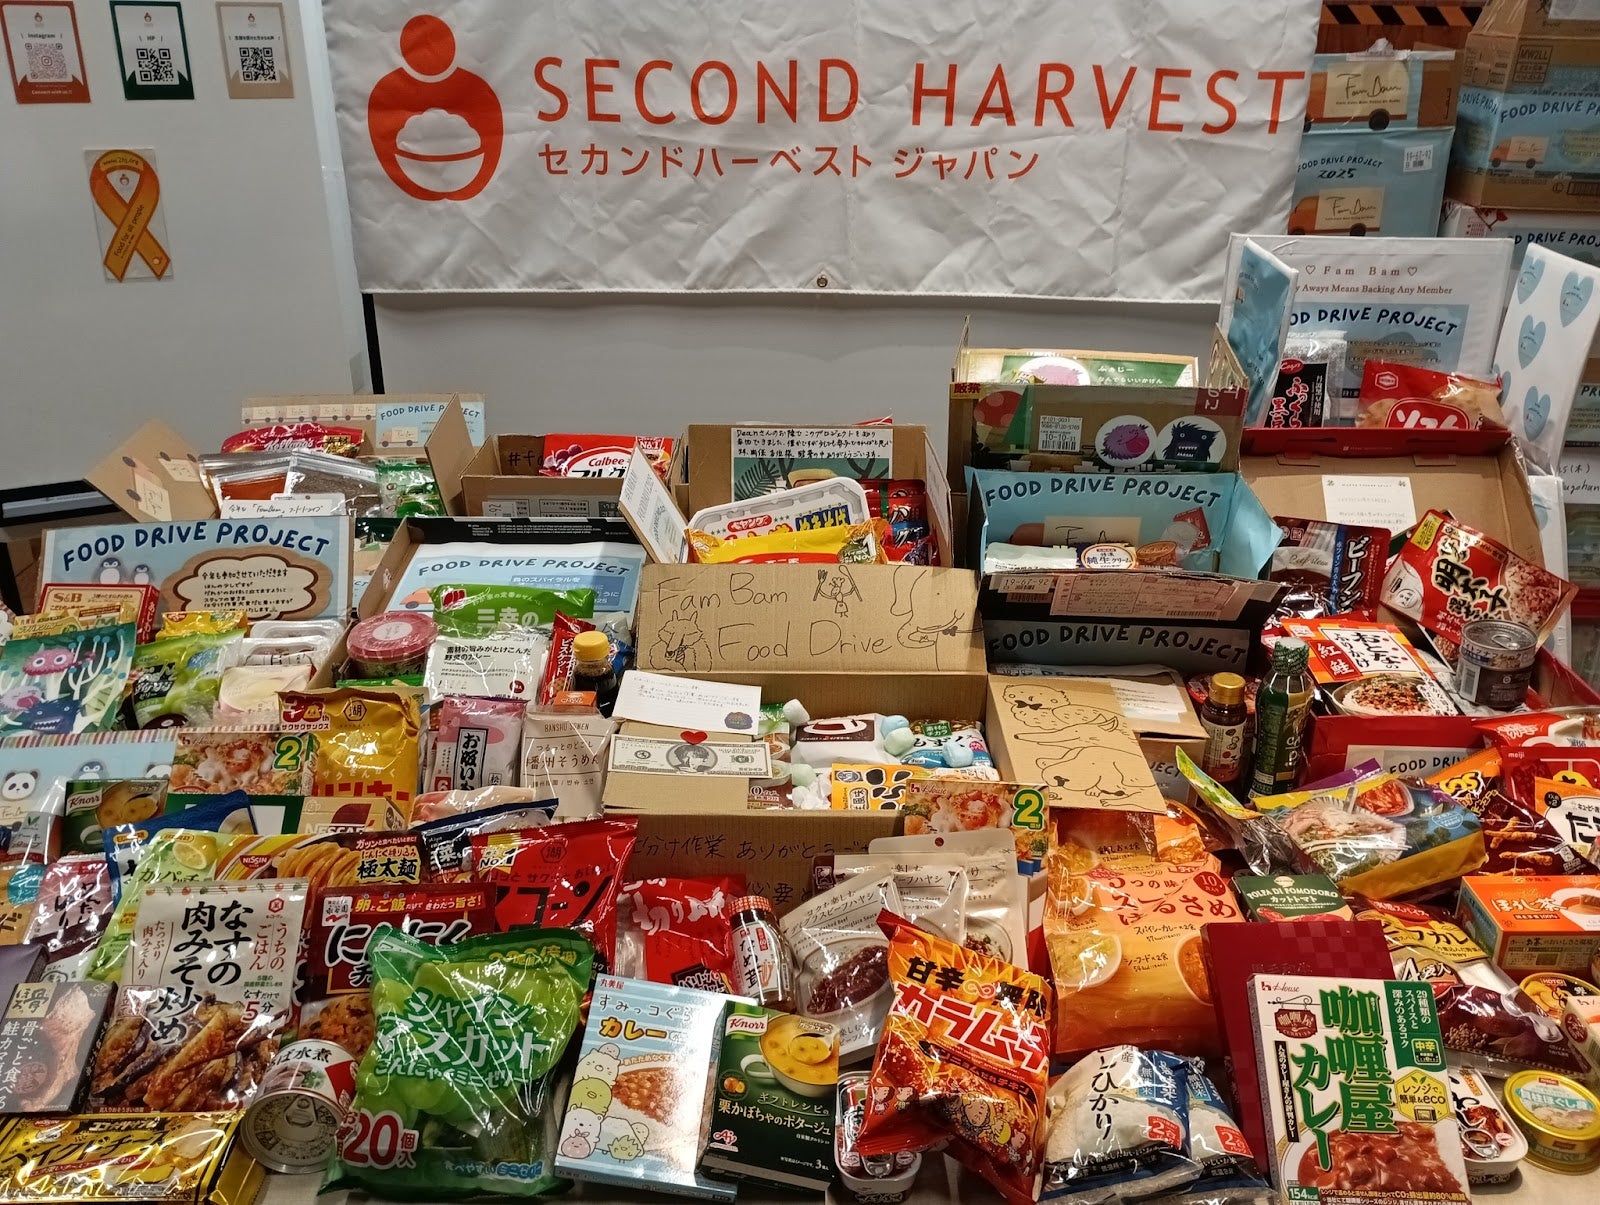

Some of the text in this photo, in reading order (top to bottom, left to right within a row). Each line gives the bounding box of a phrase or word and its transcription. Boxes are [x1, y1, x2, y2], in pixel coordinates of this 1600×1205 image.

[534, 57, 1306, 135] SECOND HARVEST
[1501, 101, 1583, 123] FOOD DRIVE
[538, 143, 1038, 181] セカンドハーベスト ジャパン
[1297, 155, 1384, 173] FOOD DRIVE PROJECT
[1318, 168, 1358, 180] 2025
[113, 241, 126, 257] Food
[1527, 231, 1566, 245] DRIVE
[1324, 266, 1400, 276] Fam Bam
[1302, 284, 1453, 297] Aways Means Backing Any Member
[1318, 307, 1458, 337] DRIVE PROJECT
[380, 404, 436, 421] FOOD DRIVE
[588, 456, 625, 468] Calbee
[985, 476, 1222, 508] FOOD DRIVE PROJECT
[731, 515, 768, 530] ペヤング
[63, 520, 331, 572] FOOD DRIVE PROJECT
[418, 558, 630, 578] FOOD DRIVE PROJECT
[1289, 554, 1308, 566] Beef
[53, 592, 83, 604] S&B
[657, 572, 788, 613] Fam Bam
[477, 606, 540, 631] 三幸の
[446, 645, 532, 656] 素材の旨みがとけこんだ
[716, 618, 894, 662] Food Drive
[988, 624, 1247, 664] FOOD DRIVE PROJECT
[1333, 632, 1371, 669] ふりかけ
[444, 652, 492, 662] 野菜のカレー
[556, 638, 574, 676] ビスケット
[1317, 642, 1355, 676] 紅鮭
[281, 722, 330, 731] サクサクサンクス
[276, 736, 302, 768] 2
[526, 754, 600, 770] 播州そうめん
[1389, 760, 1427, 775] FOOD
[920, 784, 948, 795] House
[68, 795, 101, 809] Knorr
[1013, 789, 1043, 827] 2
[242, 857, 268, 865] NISSIN
[361, 846, 417, 860] にんにく練り込み
[356, 858, 419, 881] 極太麺
[1200, 874, 1217, 886] 10
[355, 895, 482, 913] 卵とご飯だけで きわだつ旨さ!
[1246, 888, 1339, 900] POLPA DI POMODORO
[1270, 894, 1318, 904] カットトマト
[1491, 898, 1568, 912] ほうじ茶
[152, 919, 169, 962] たっぷり
[208, 900, 255, 987] なすの
[248, 923, 272, 971] ごはん
[270, 922, 288, 972] うちの
[325, 918, 473, 968] ににく
[136, 925, 155, 981] 肉みそ入り
[739, 938, 758, 989] なめ茸
[150, 900, 217, 1045] 肉みそ炒め
[906, 956, 965, 992] 甘辛
[1400, 956, 1452, 982] 4袋入
[243, 989, 280, 1000] なすだけで
[600, 978, 625, 991] 丸美屋
[1274, 982, 1300, 993] House
[25, 988, 50, 1014] 骨
[240, 1000, 274, 1022] 5分
[406, 989, 533, 1027] シャイン
[598, 993, 692, 1022] すみっコぐら
[1404, 990, 1420, 1030] スパイスと
[1416, 990, 1432, 1024] 29種類の
[598, 1016, 668, 1042] カレー
[728, 1016, 767, 1034] Knorr
[1392, 988, 1409, 1049] 深みのあるコク
[1414, 1040, 1436, 1052] 中辛
[1399, 1094, 1446, 1106] 簡単&eco
[1402, 1084, 1440, 1096] レンジで
[760, 1092, 830, 1116] ギフトレシピの
[1290, 1043, 1341, 1172] カレー
[718, 1098, 832, 1137] 栗かぼちゃのポタージュ
[343, 1112, 417, 1169] 20 個入
[444, 1161, 496, 1175] 食べやすい
[1289, 1188, 1318, 1200] 154kcal
